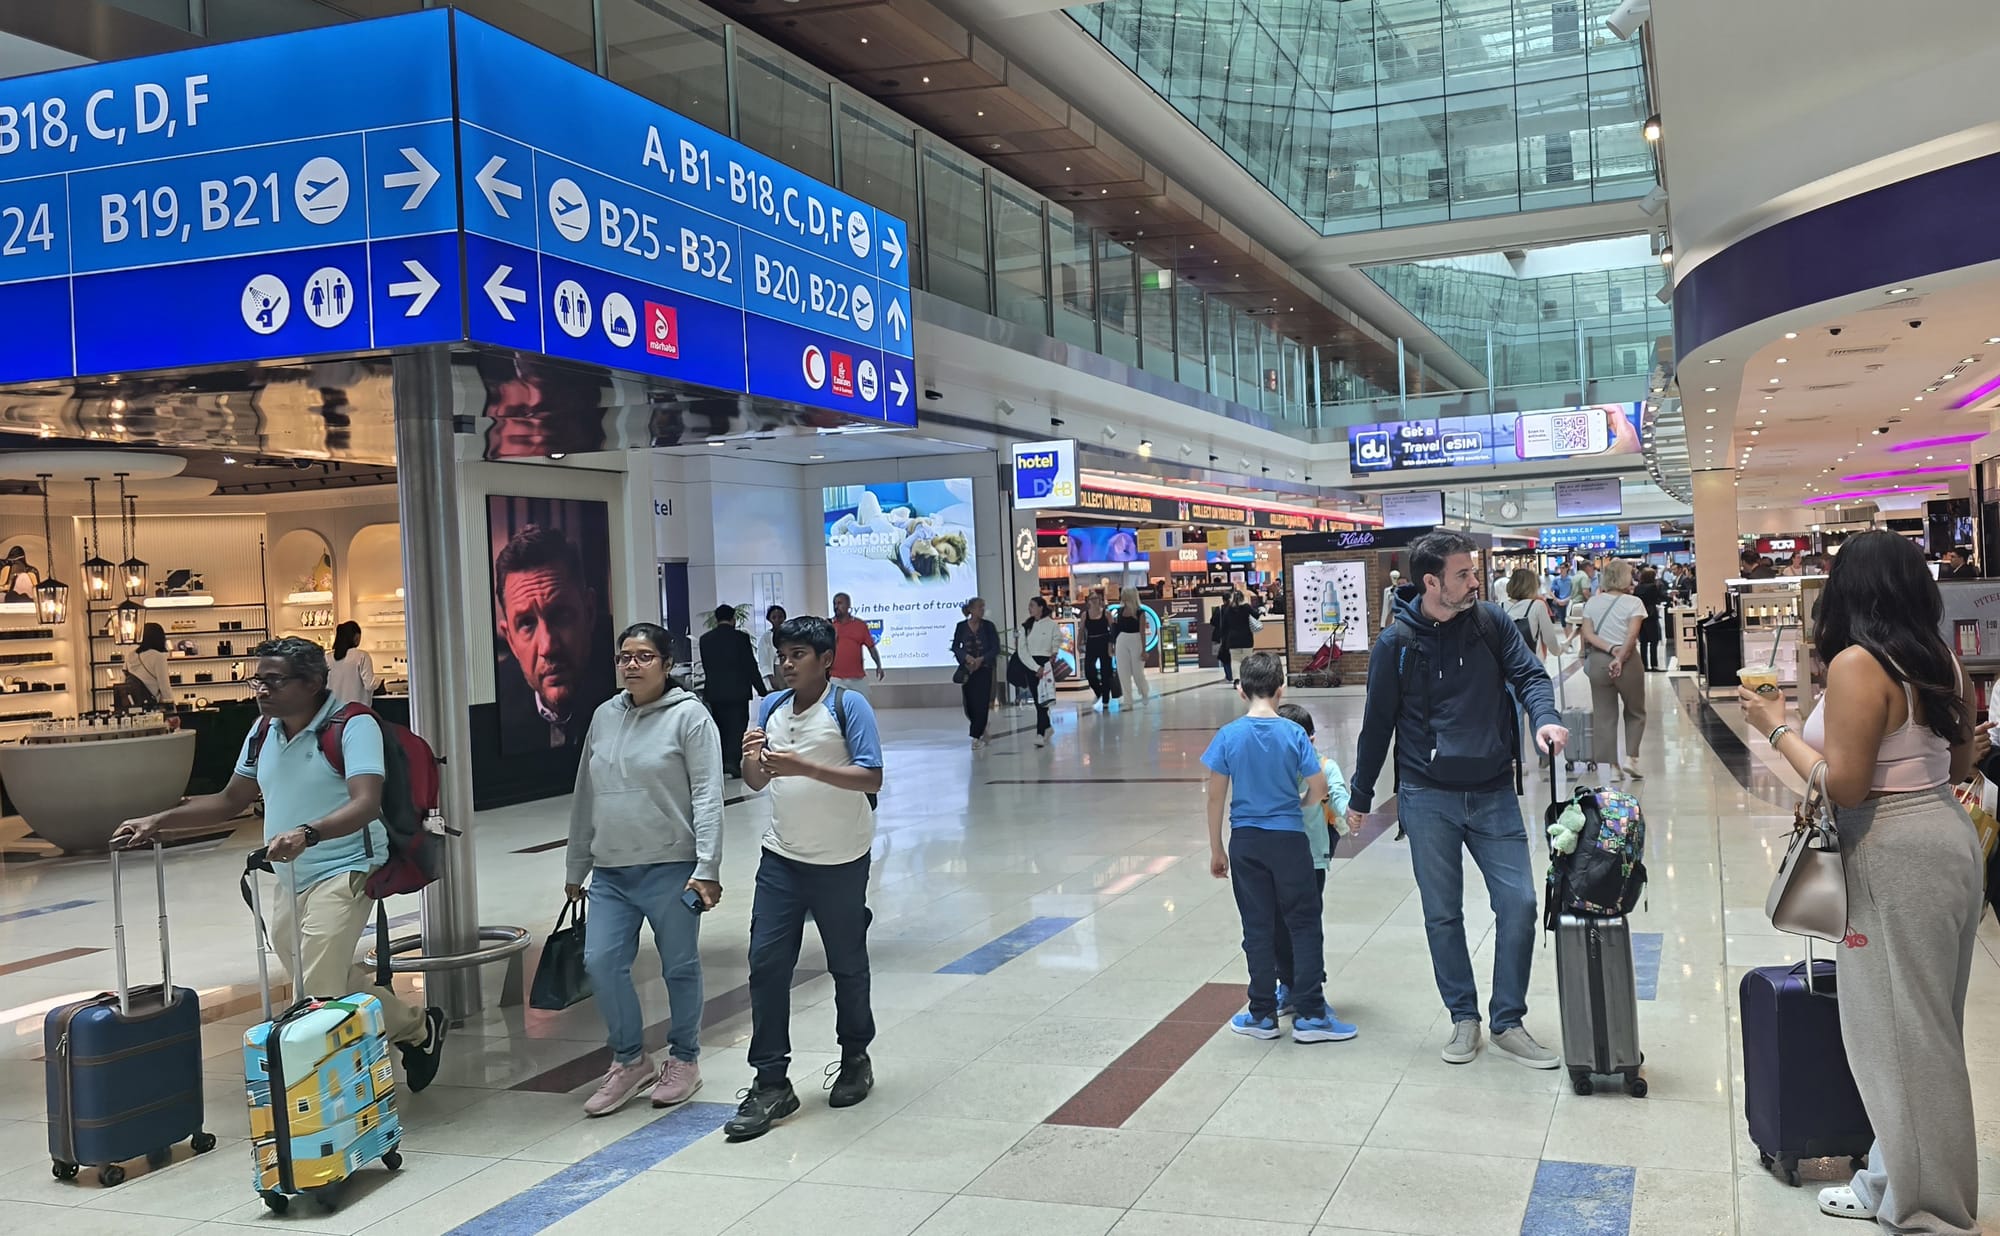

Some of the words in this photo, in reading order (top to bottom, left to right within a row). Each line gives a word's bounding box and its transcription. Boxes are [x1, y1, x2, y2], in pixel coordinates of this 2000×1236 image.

[1401, 426, 1424, 437] Get
[1425, 427, 1434, 436] a
[1361, 439, 1386, 459] du
[1401, 440, 1440, 453] Travel
[1446, 438, 1478, 450] eSIM
[1017, 453, 1053, 469] hotel
[654, 498, 673, 516] tel
[1081, 491, 1103, 508] OLLECT
[1114, 495, 1130, 511] YOUR
[829, 533, 899, 547] COMFORT
[1338, 532, 1375, 547] Kiehl's
[861, 603, 871, 613] in
[873, 602, 890, 613] the
[892, 601, 920, 612] heart
[923, 599, 935, 610] of
